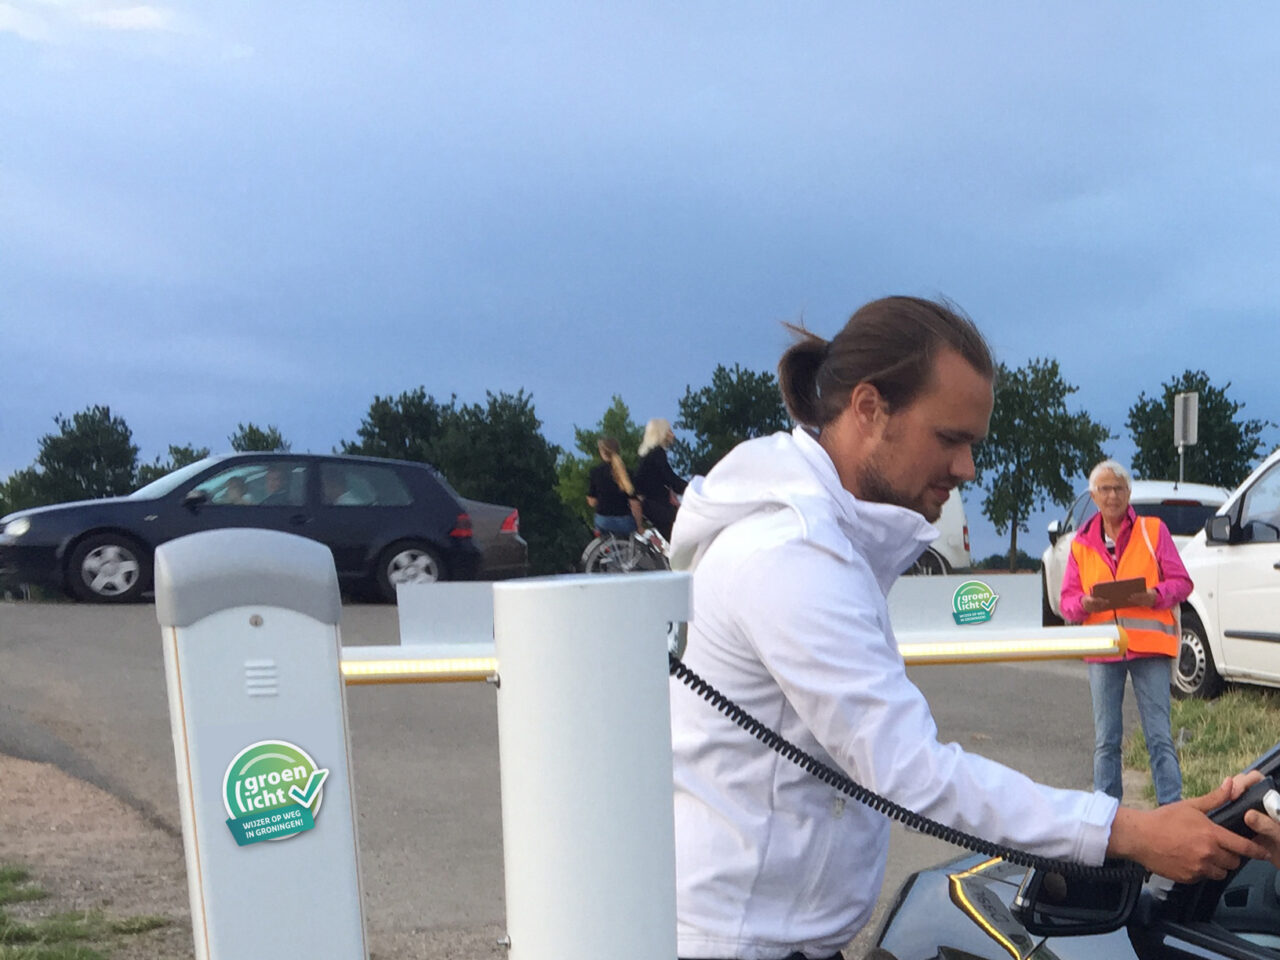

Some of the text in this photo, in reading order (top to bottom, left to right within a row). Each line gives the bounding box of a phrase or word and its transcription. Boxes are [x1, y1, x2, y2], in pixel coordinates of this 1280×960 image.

[962, 592, 990, 604] groen
[244, 765, 308, 795] groen
[242, 810, 301, 830] WIJZER OP WEG
[245, 819, 304, 839] IN GRONINGEN!
